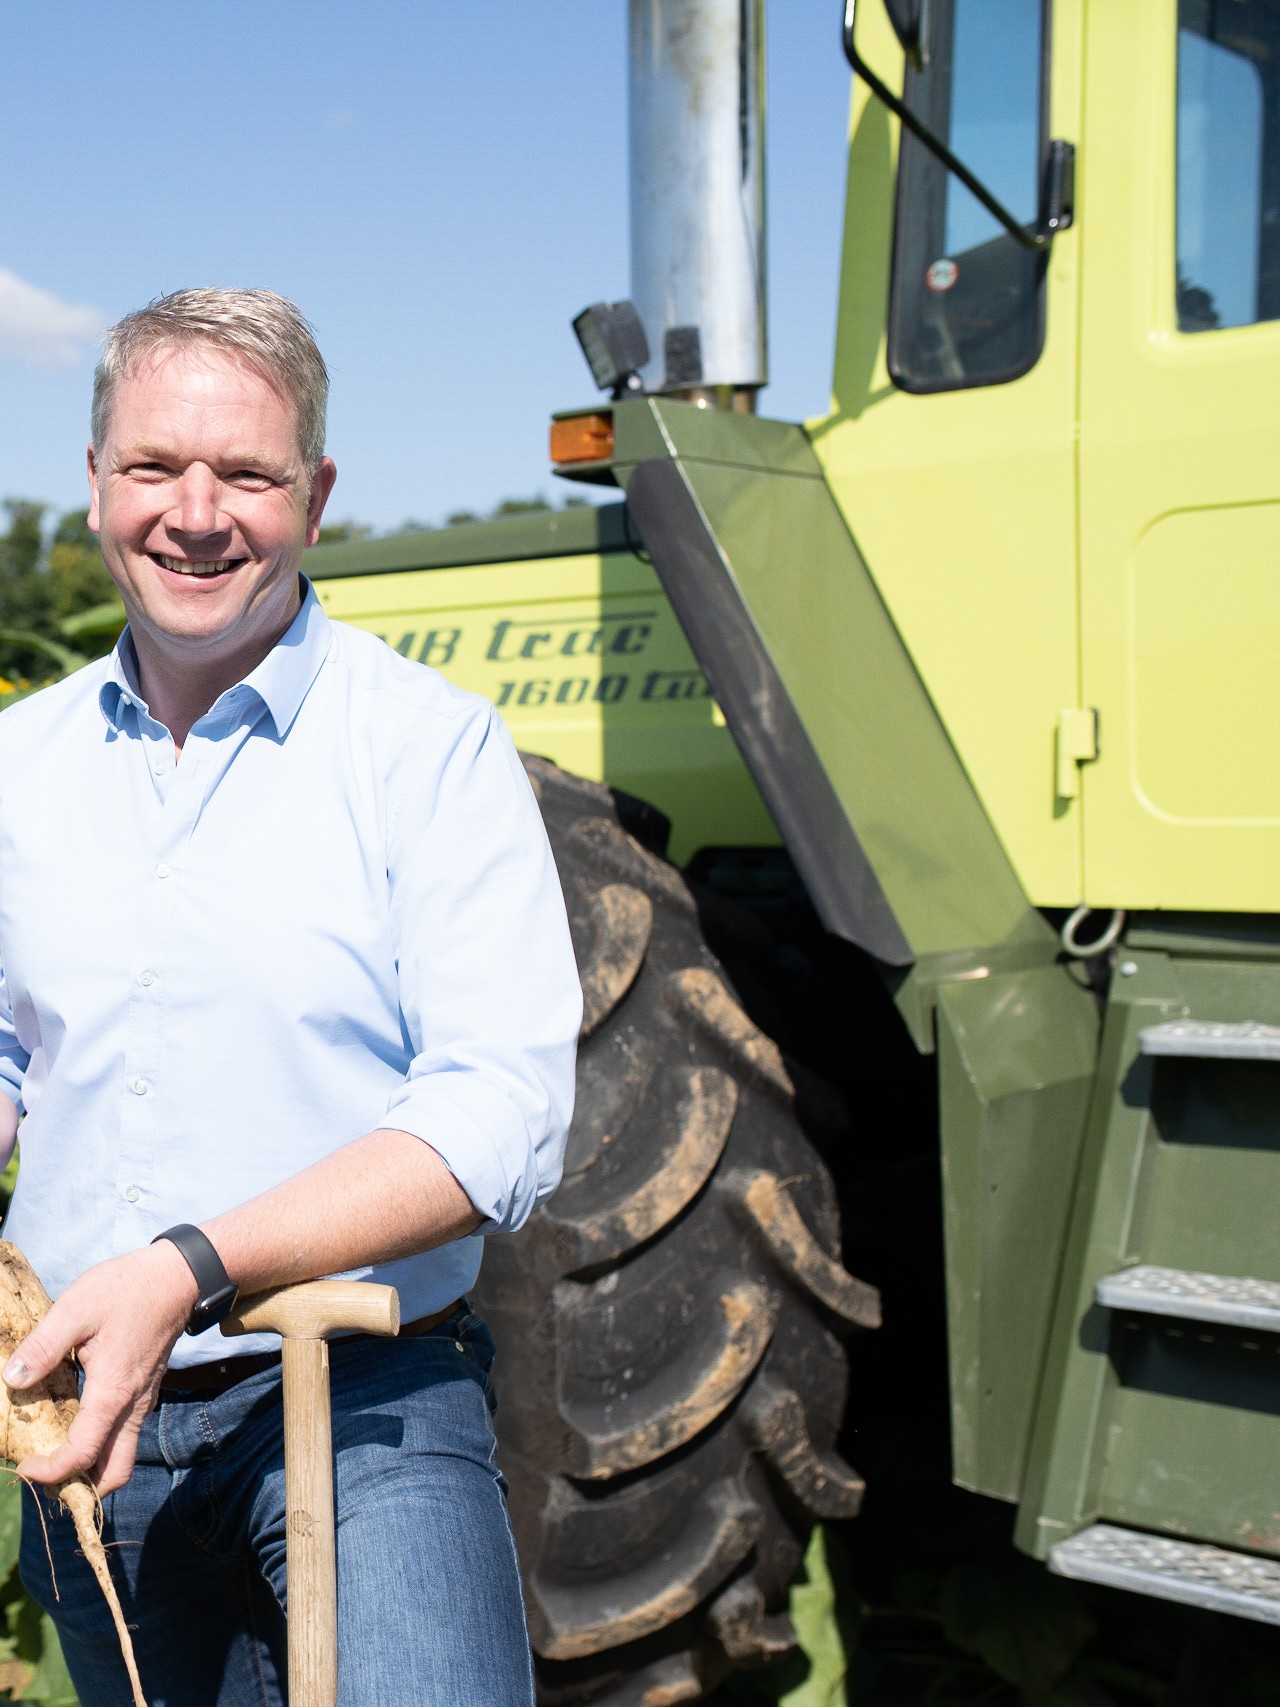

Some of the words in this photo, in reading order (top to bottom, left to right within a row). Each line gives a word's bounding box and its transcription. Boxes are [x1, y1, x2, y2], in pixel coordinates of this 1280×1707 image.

[485, 611, 657, 662] trac
[496, 672, 629, 707] 1600
[640, 669, 712, 701] tu
